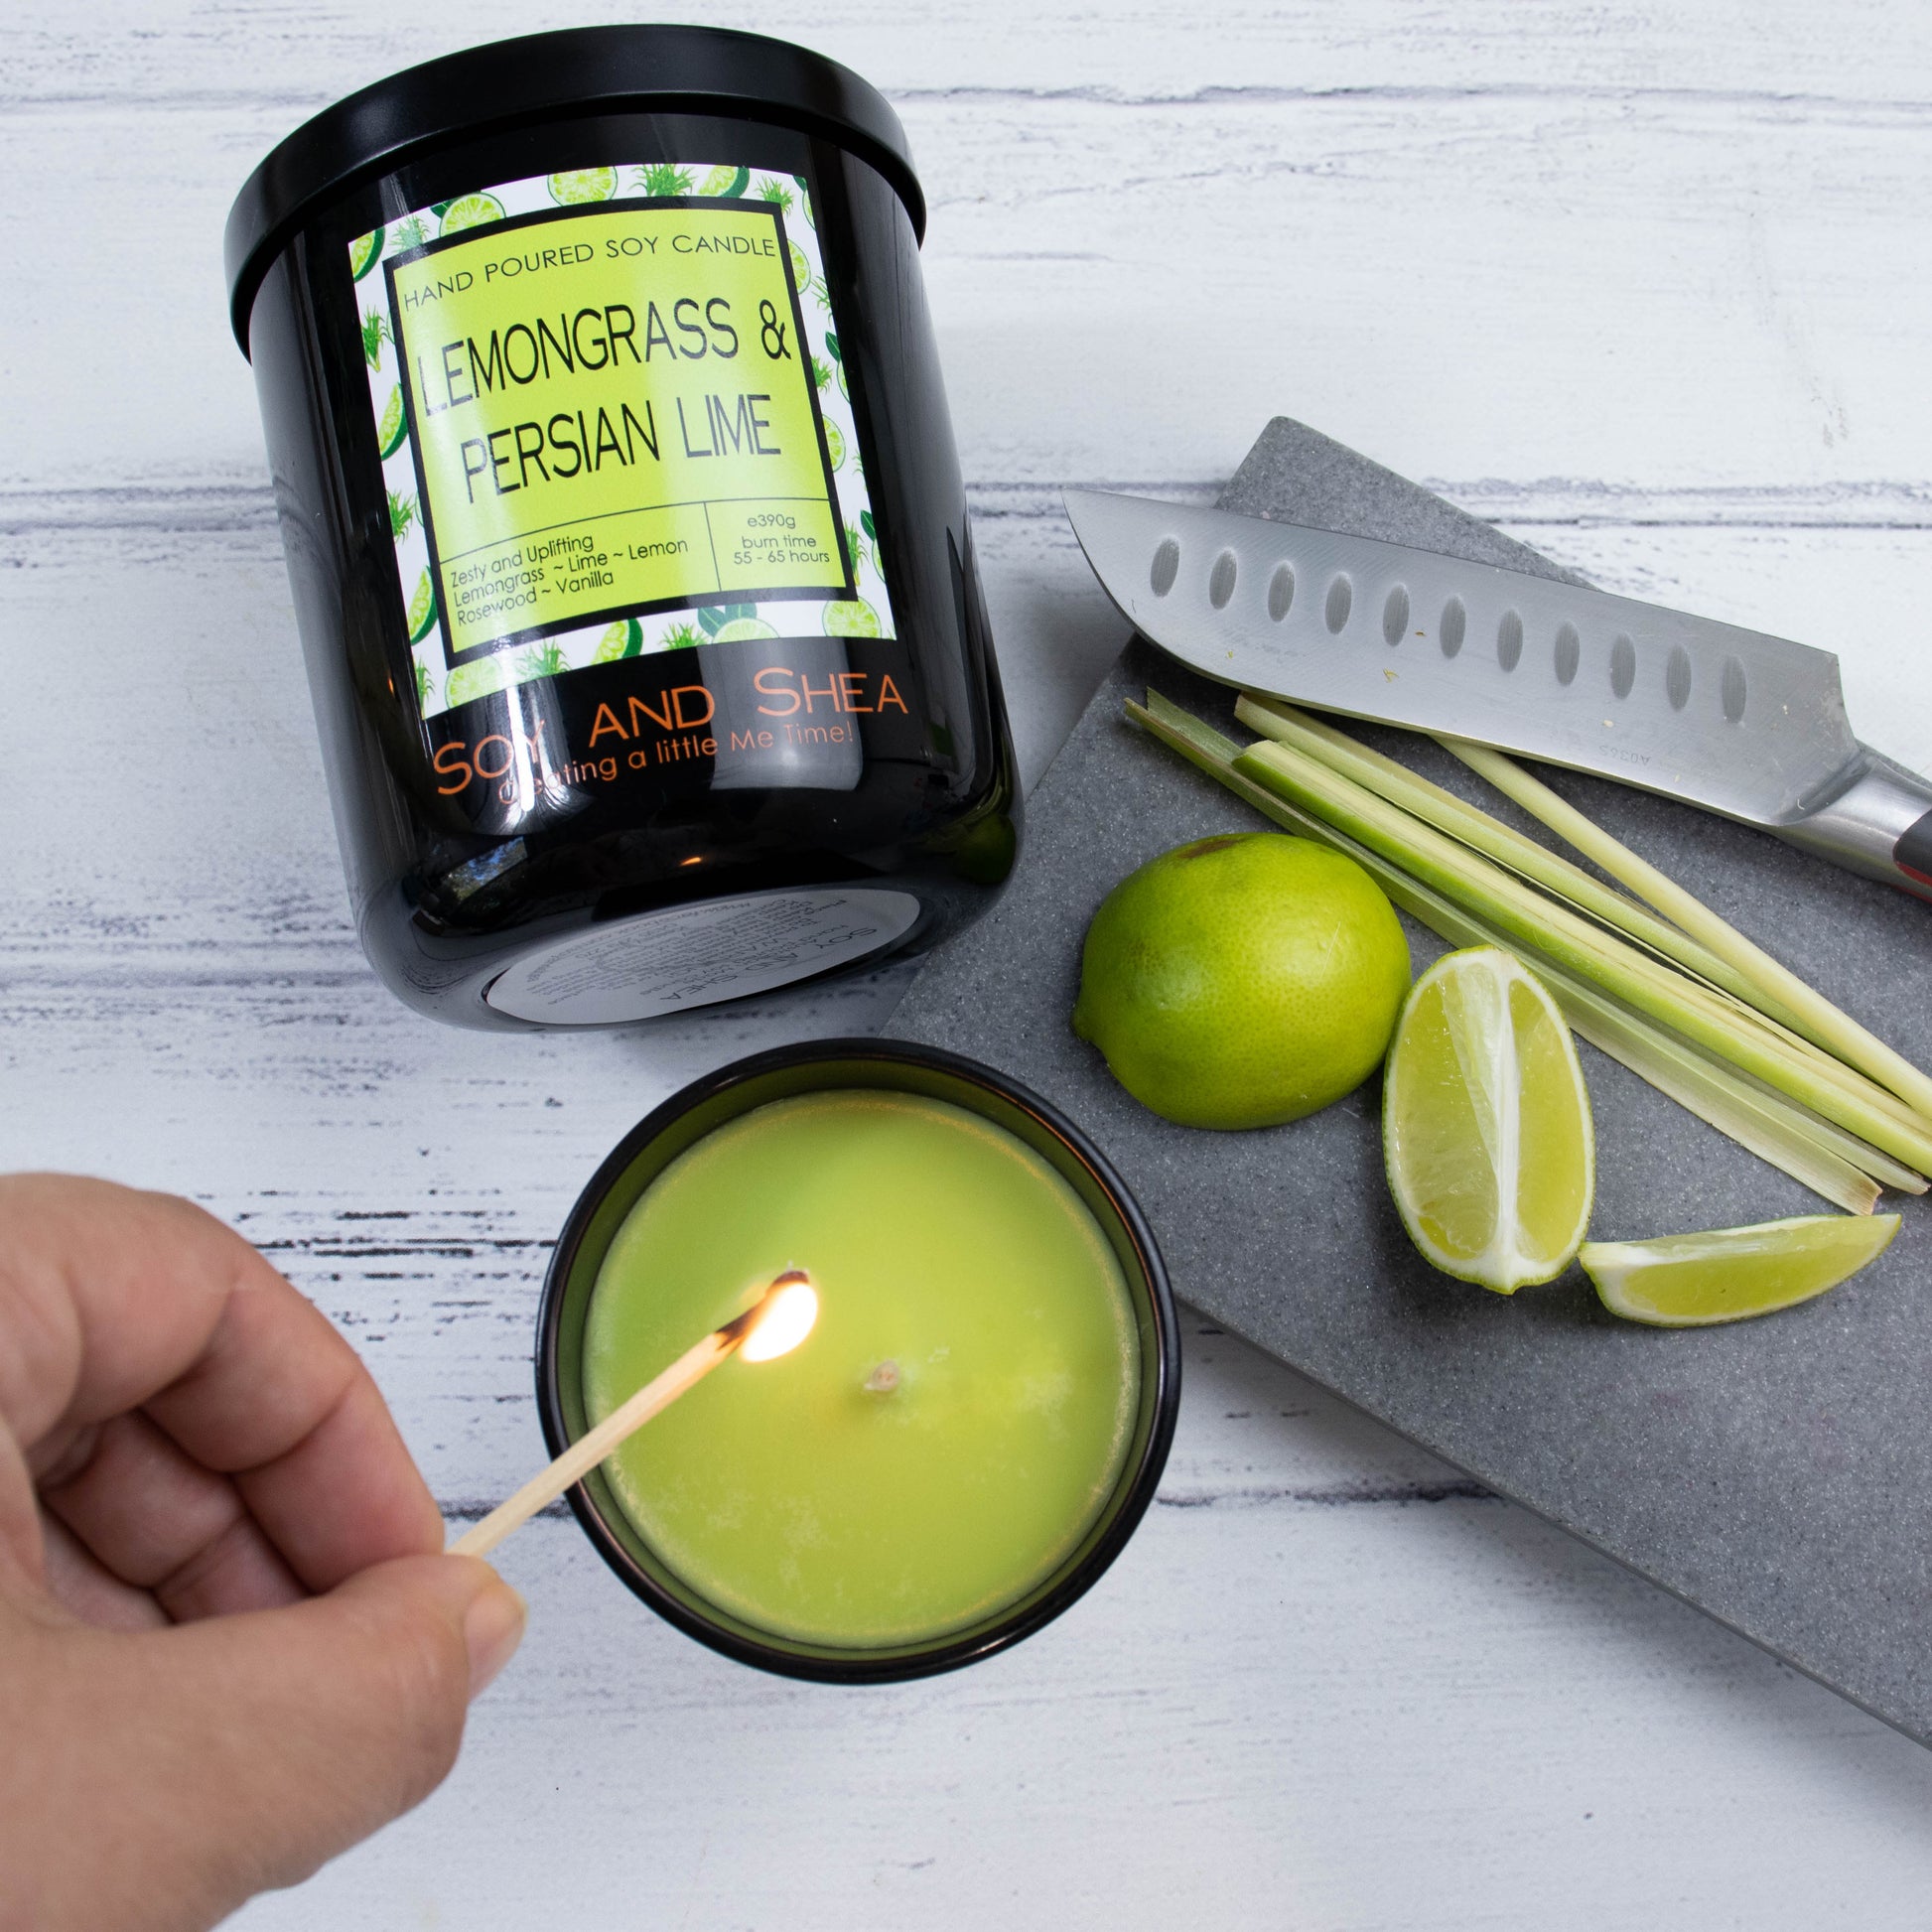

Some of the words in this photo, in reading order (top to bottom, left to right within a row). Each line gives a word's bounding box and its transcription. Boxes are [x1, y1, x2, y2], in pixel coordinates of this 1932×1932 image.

[404, 269, 474, 312] HAND
[484, 244, 594, 283] POURED
[606, 236, 658, 258] SOY
[672, 234, 776, 257] CANDLE
[417, 298, 739, 417] LEMONGRASS
[759, 299, 792, 360] &
[460, 400, 661, 504] PERSIAN
[676, 393, 782, 459] LIME
[741, 535, 779, 549] burn
[782, 534, 817, 547] time
[747, 513, 796, 530] e390g
[451, 563, 486, 588] Zesty
[490, 550, 523, 573] and
[526, 535, 594, 563] Uplifting
[454, 567, 545, 608] Lemongrass
[568, 553, 609, 573] Lime
[628, 539, 689, 560] Lemon
[733, 551, 753, 565] 55
[767, 550, 786, 563] 65
[788, 549, 830, 563] hours
[457, 586, 537, 626] Rosewood
[555, 571, 615, 595] Vanilla
[433, 720, 546, 795] SOY
[588, 684, 716, 749] AND
[753, 666, 909, 717] SHEA
[627, 750, 646, 769] a
[656, 735, 719, 764] little
[730, 730, 774, 752] Me
[784, 721, 854, 746] Time!
